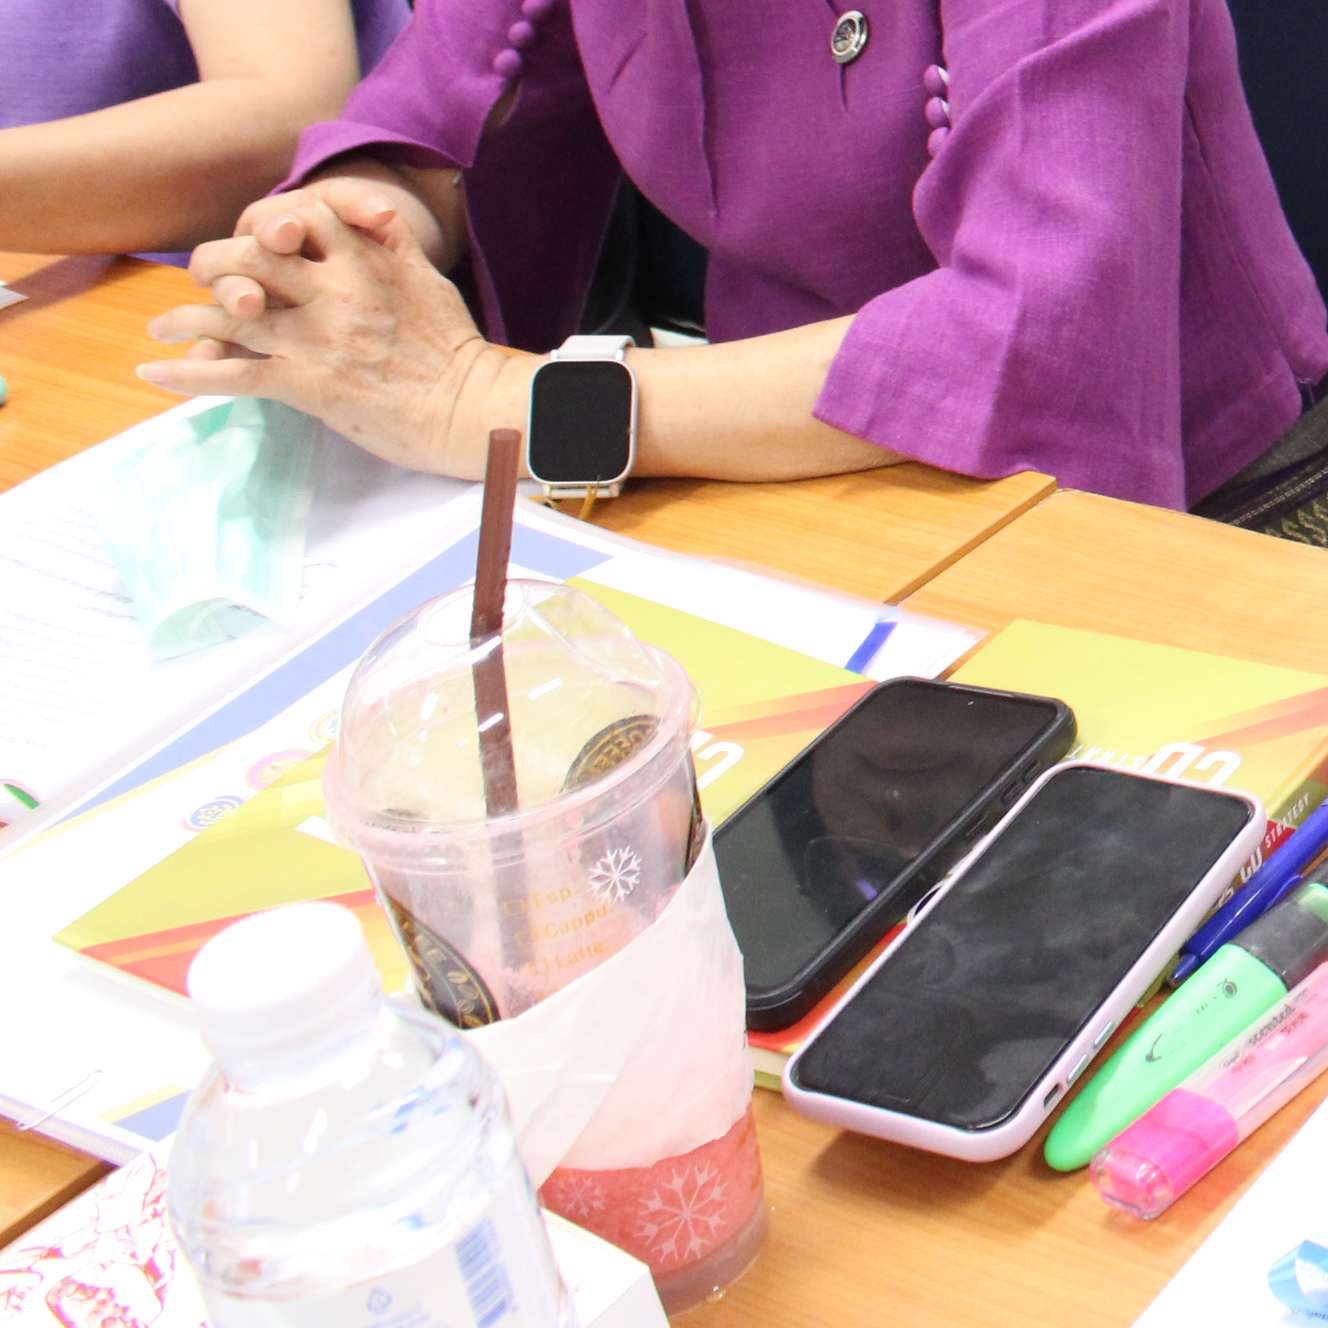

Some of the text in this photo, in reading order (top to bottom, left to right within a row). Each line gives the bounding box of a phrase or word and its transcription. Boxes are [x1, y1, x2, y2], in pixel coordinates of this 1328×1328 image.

[1065, 743, 1148, 772] STRAT
[1265, 791, 1310, 849] STRATEGY
[531, 884, 579, 912] Esp.
[542, 903, 617, 943] Cappu.
[1247, 997, 1297, 1049] scented
